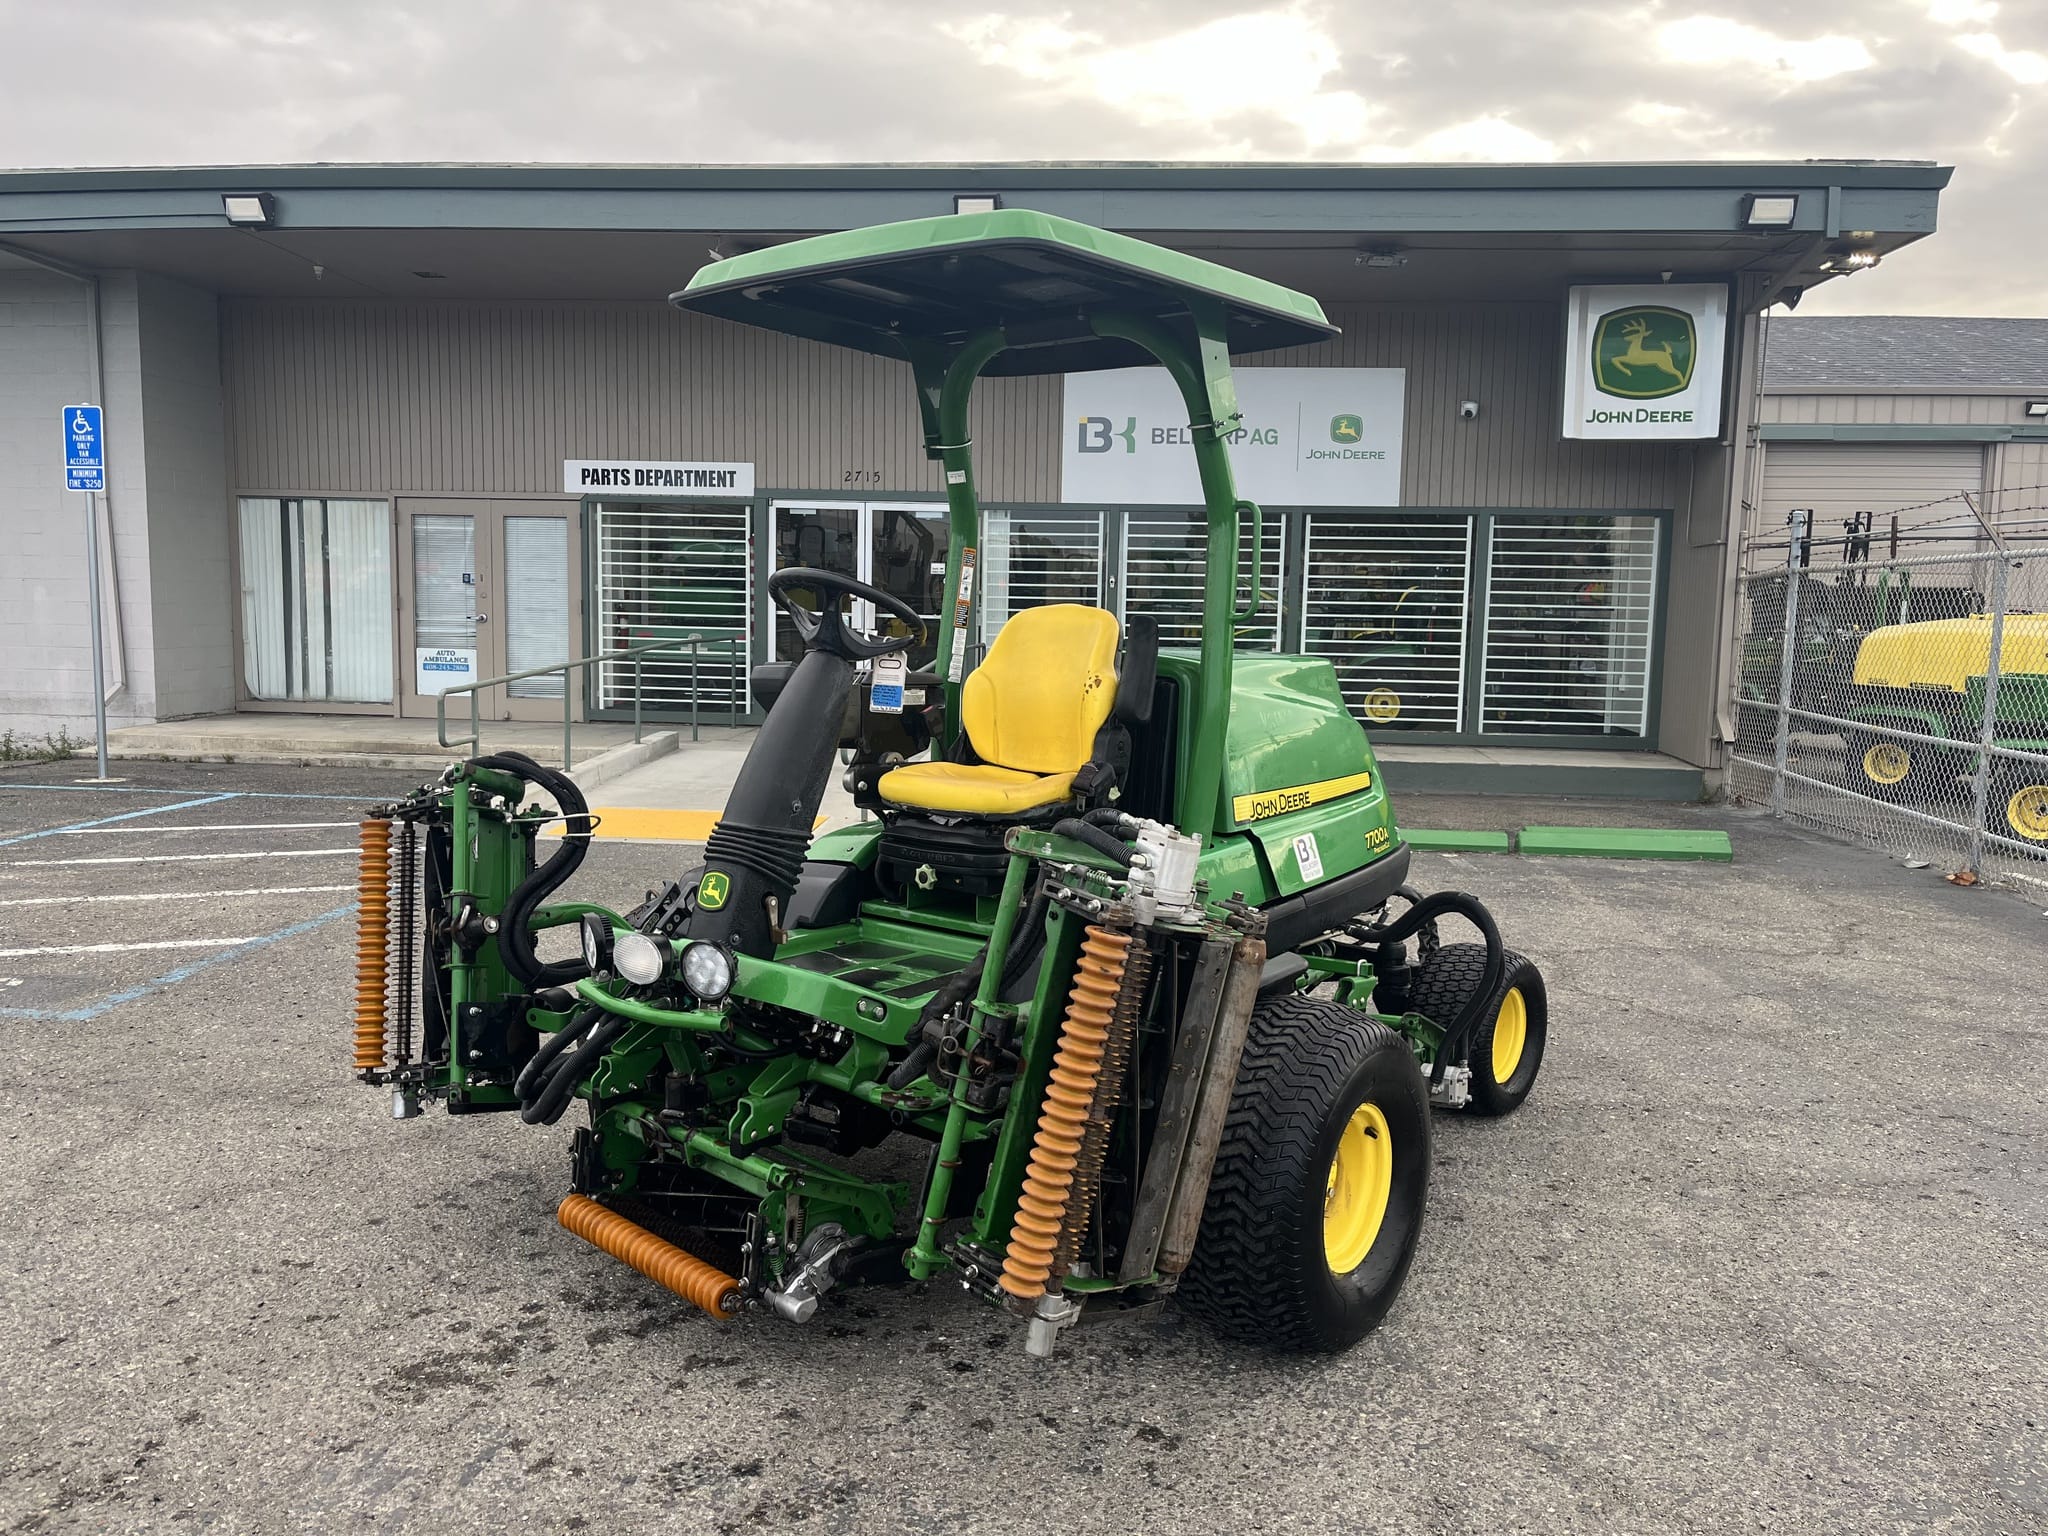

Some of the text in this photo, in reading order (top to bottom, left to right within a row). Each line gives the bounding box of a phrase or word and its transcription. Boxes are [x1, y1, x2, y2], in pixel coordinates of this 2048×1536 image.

[1585, 409, 1693, 423] JOHN DEERE
[1305, 449, 1385, 459] JOHN DEERE
[72, 470, 97, 478] MINIMUM
[581, 468, 737, 488] PARTS DEPARTMENT
[844, 470, 881, 483] 2715
[1249, 791, 1311, 818] JOHN DEERE
